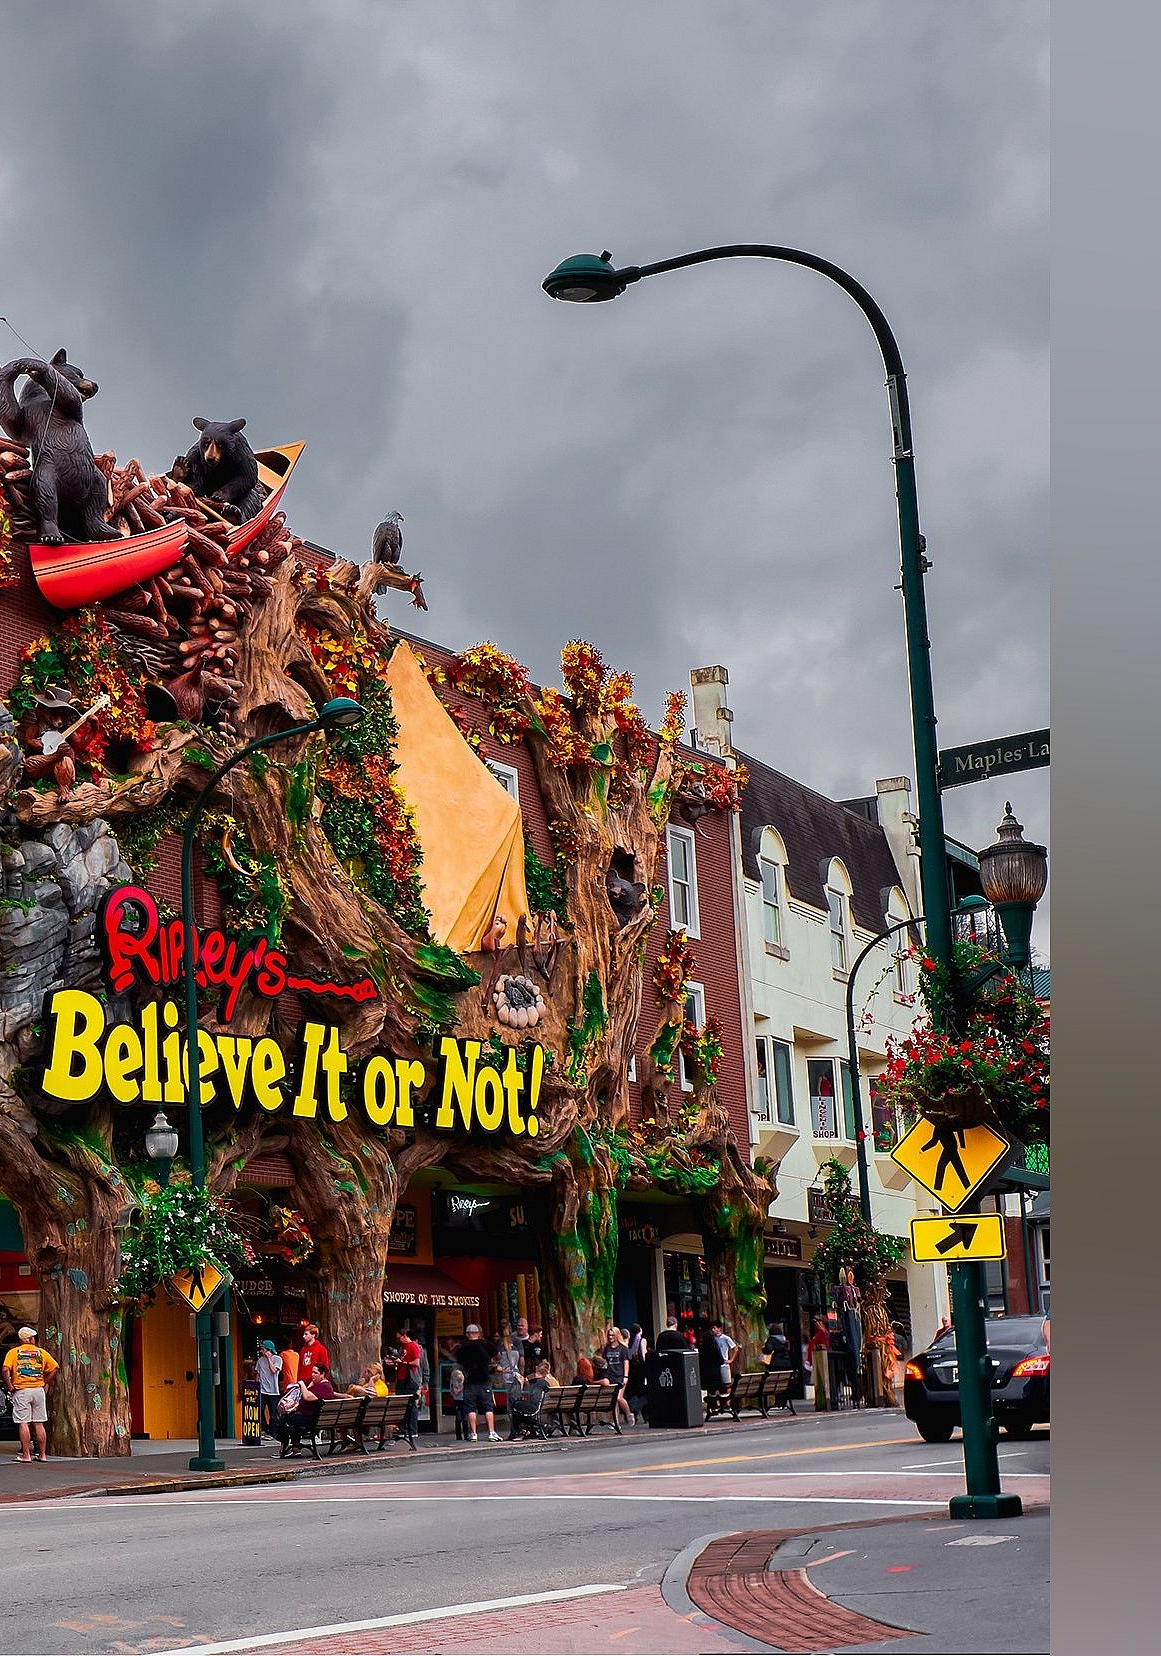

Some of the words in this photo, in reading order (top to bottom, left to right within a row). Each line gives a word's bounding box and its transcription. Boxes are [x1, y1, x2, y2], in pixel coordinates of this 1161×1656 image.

[42, 989, 286, 1112] Believe
[293, 1022, 347, 1122] It
[364, 1055, 426, 1127] or
[436, 1037, 543, 1137] Not!
[813, 1130, 835, 1138] SHOP
[383, 1291, 415, 1303] SHOPPE
[418, 1294, 428, 1304] OF
[430, 1295, 446, 1306] THE
[447, 1295, 480, 1307] SMOKIES
[244, 1405, 259, 1421] NOW
[243, 1421, 260, 1438] OPEN
